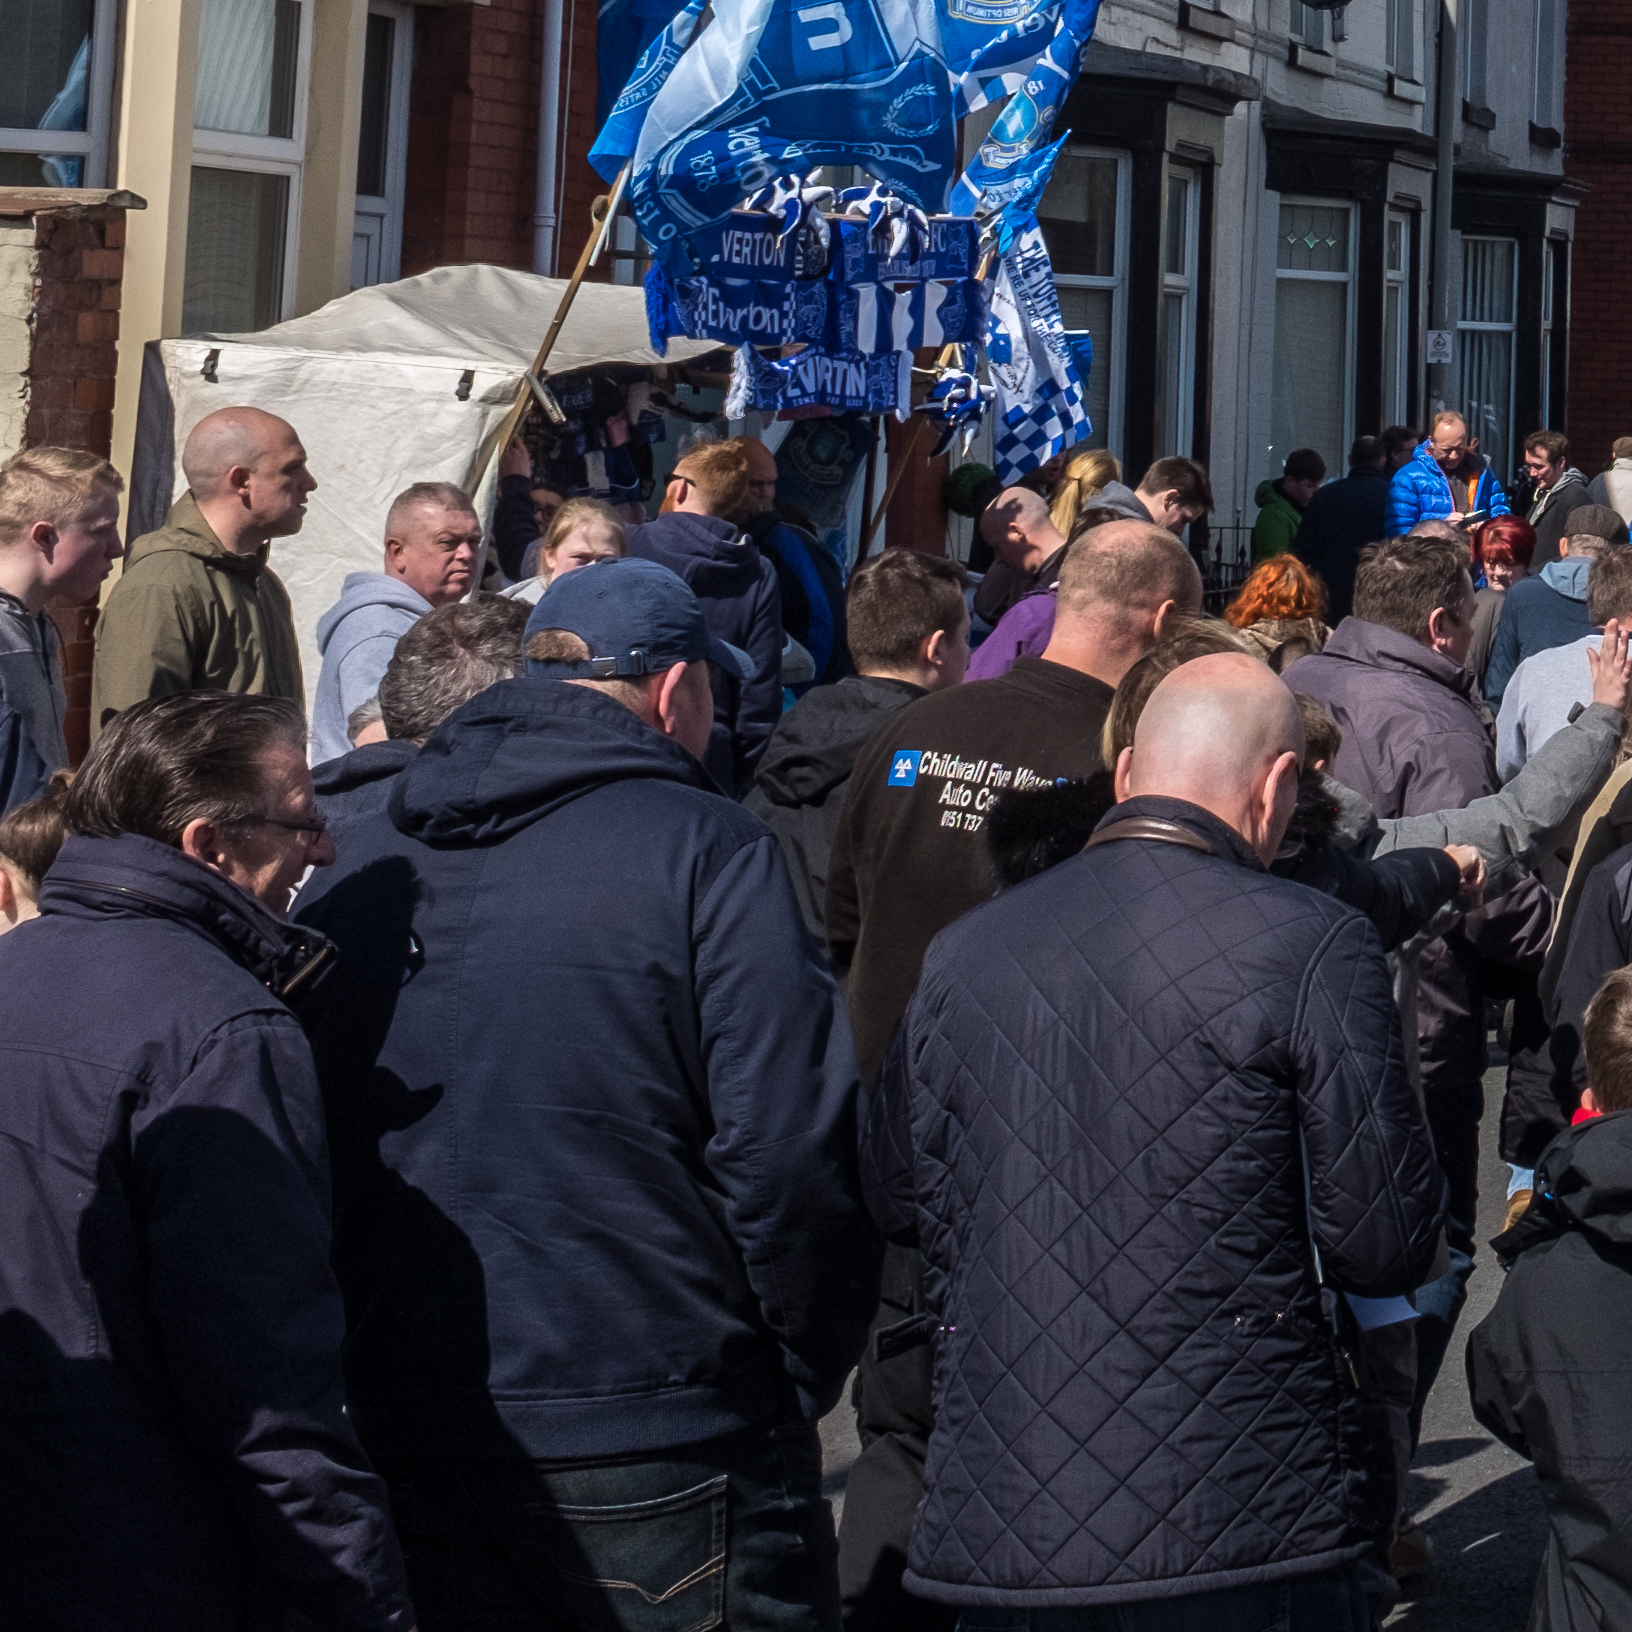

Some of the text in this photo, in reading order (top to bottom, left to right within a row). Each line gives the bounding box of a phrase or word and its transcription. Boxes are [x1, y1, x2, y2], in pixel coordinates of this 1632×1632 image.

[919, 750, 988, 785] Childwall
[985, 763, 1012, 787] Five
[938, 781, 972, 807] Auto
[940, 809, 984, 832] 0151 737
